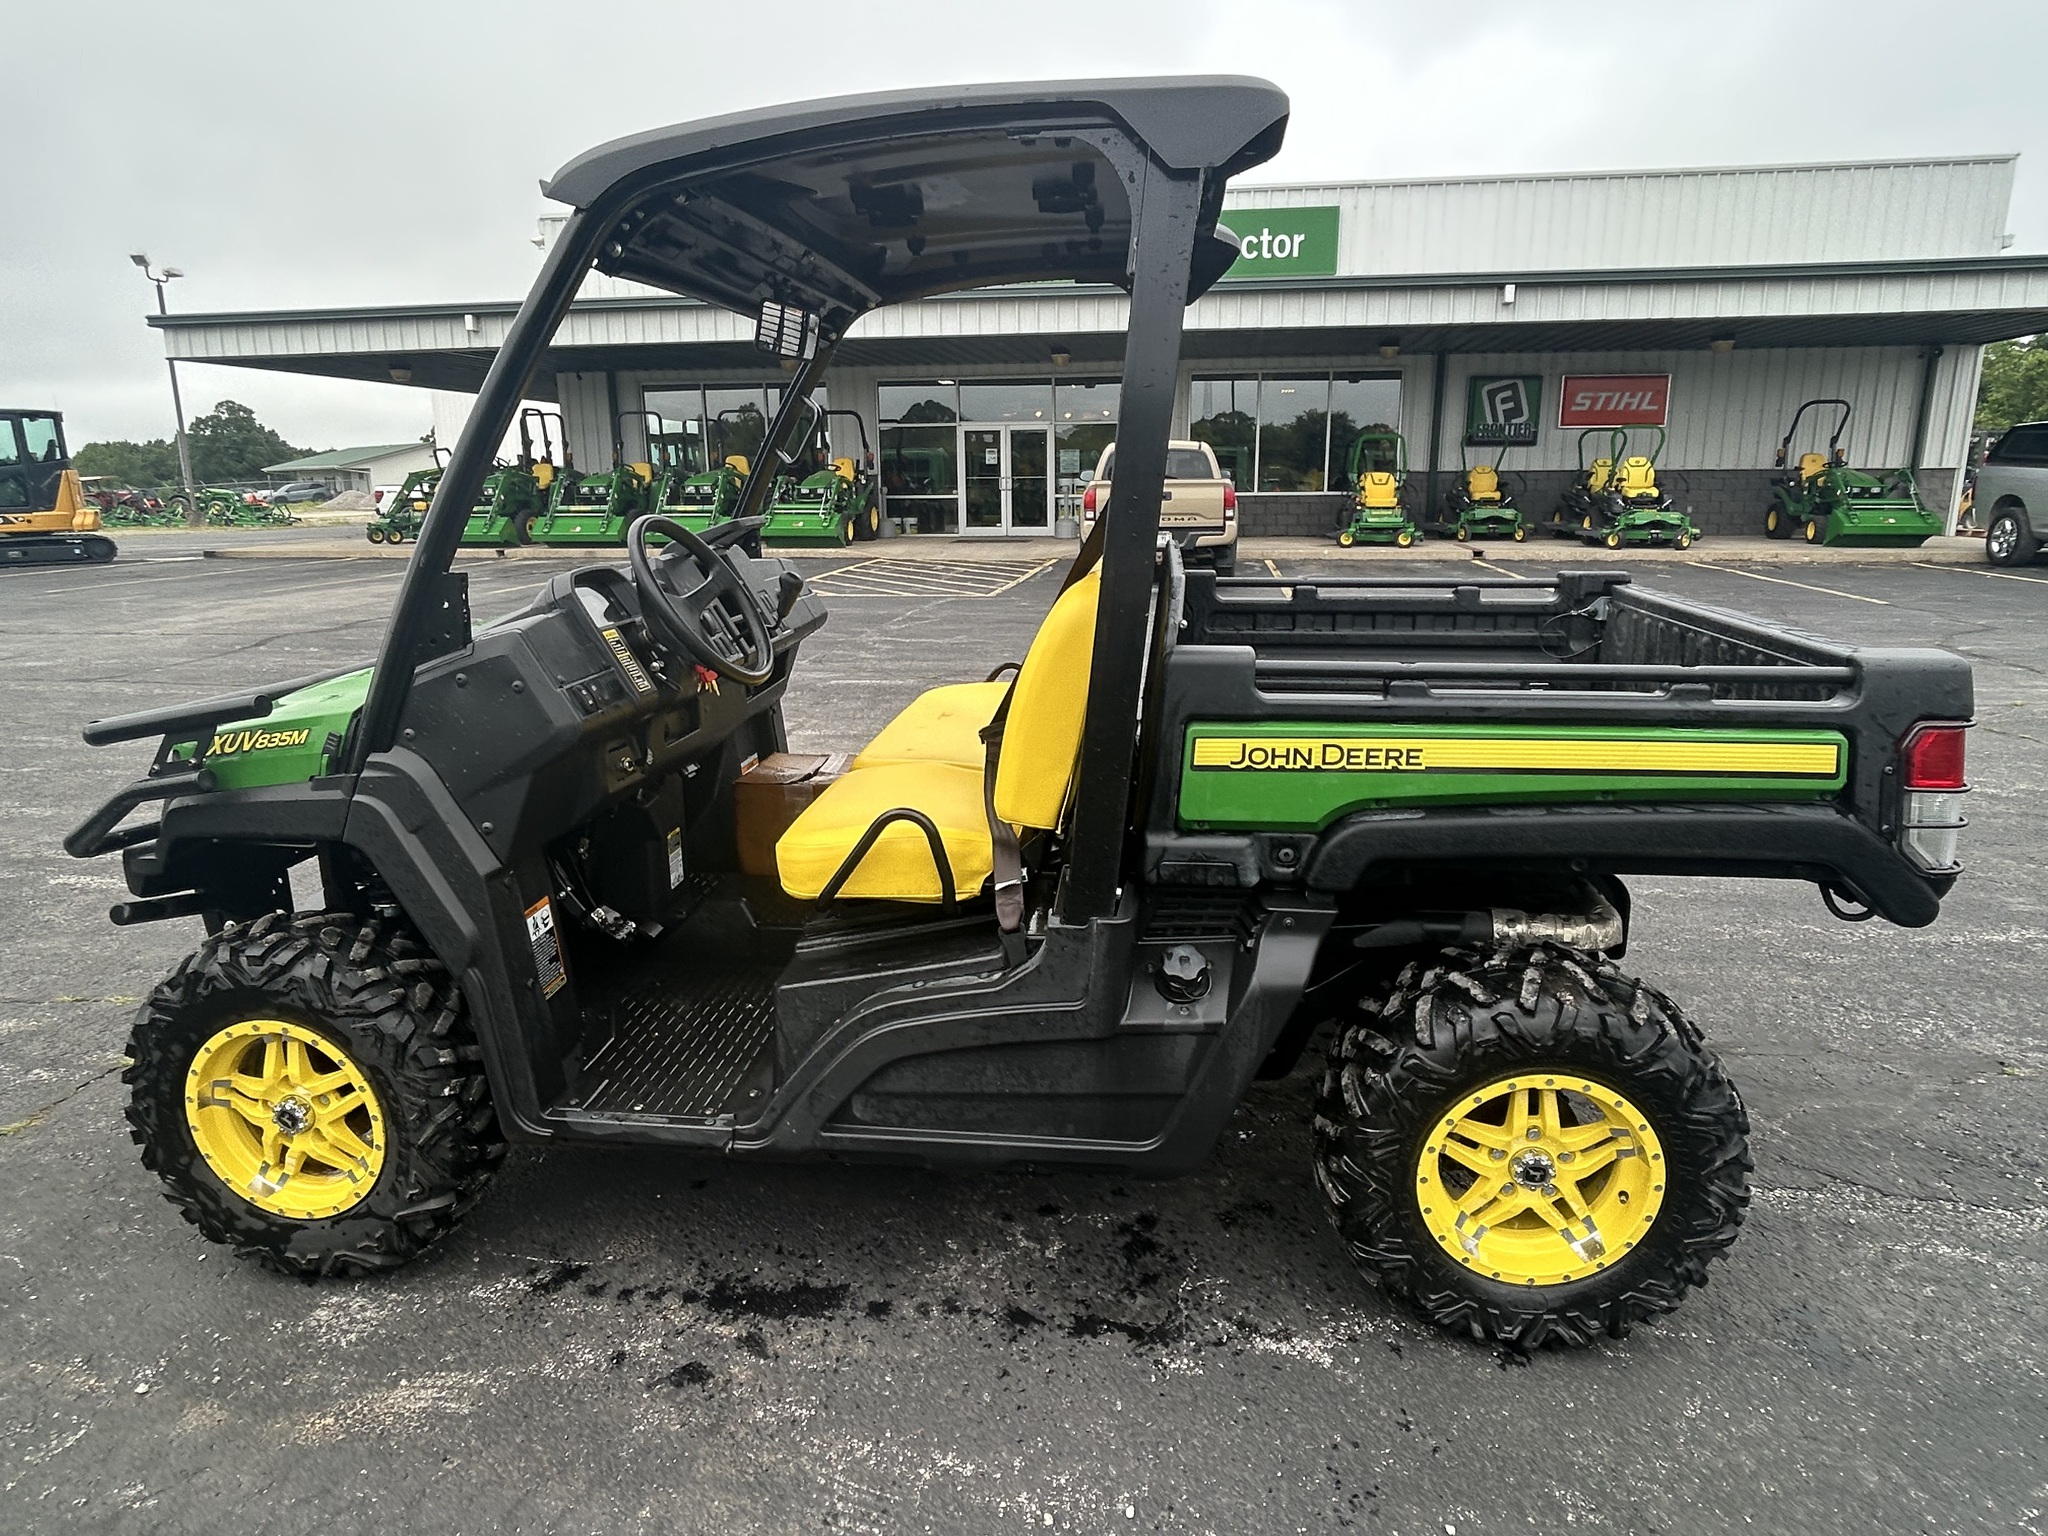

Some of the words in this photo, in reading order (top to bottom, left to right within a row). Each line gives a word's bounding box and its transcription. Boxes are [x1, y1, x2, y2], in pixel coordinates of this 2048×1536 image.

[1240, 228, 1305, 259] ctor
[1570, 390, 1660, 411] STIHL
[1476, 422, 1532, 439] FRONTIER
[205, 729, 309, 756] XUV835M
[1230, 742, 1313, 766] JOHN
[1322, 743, 1424, 767] DEERE
